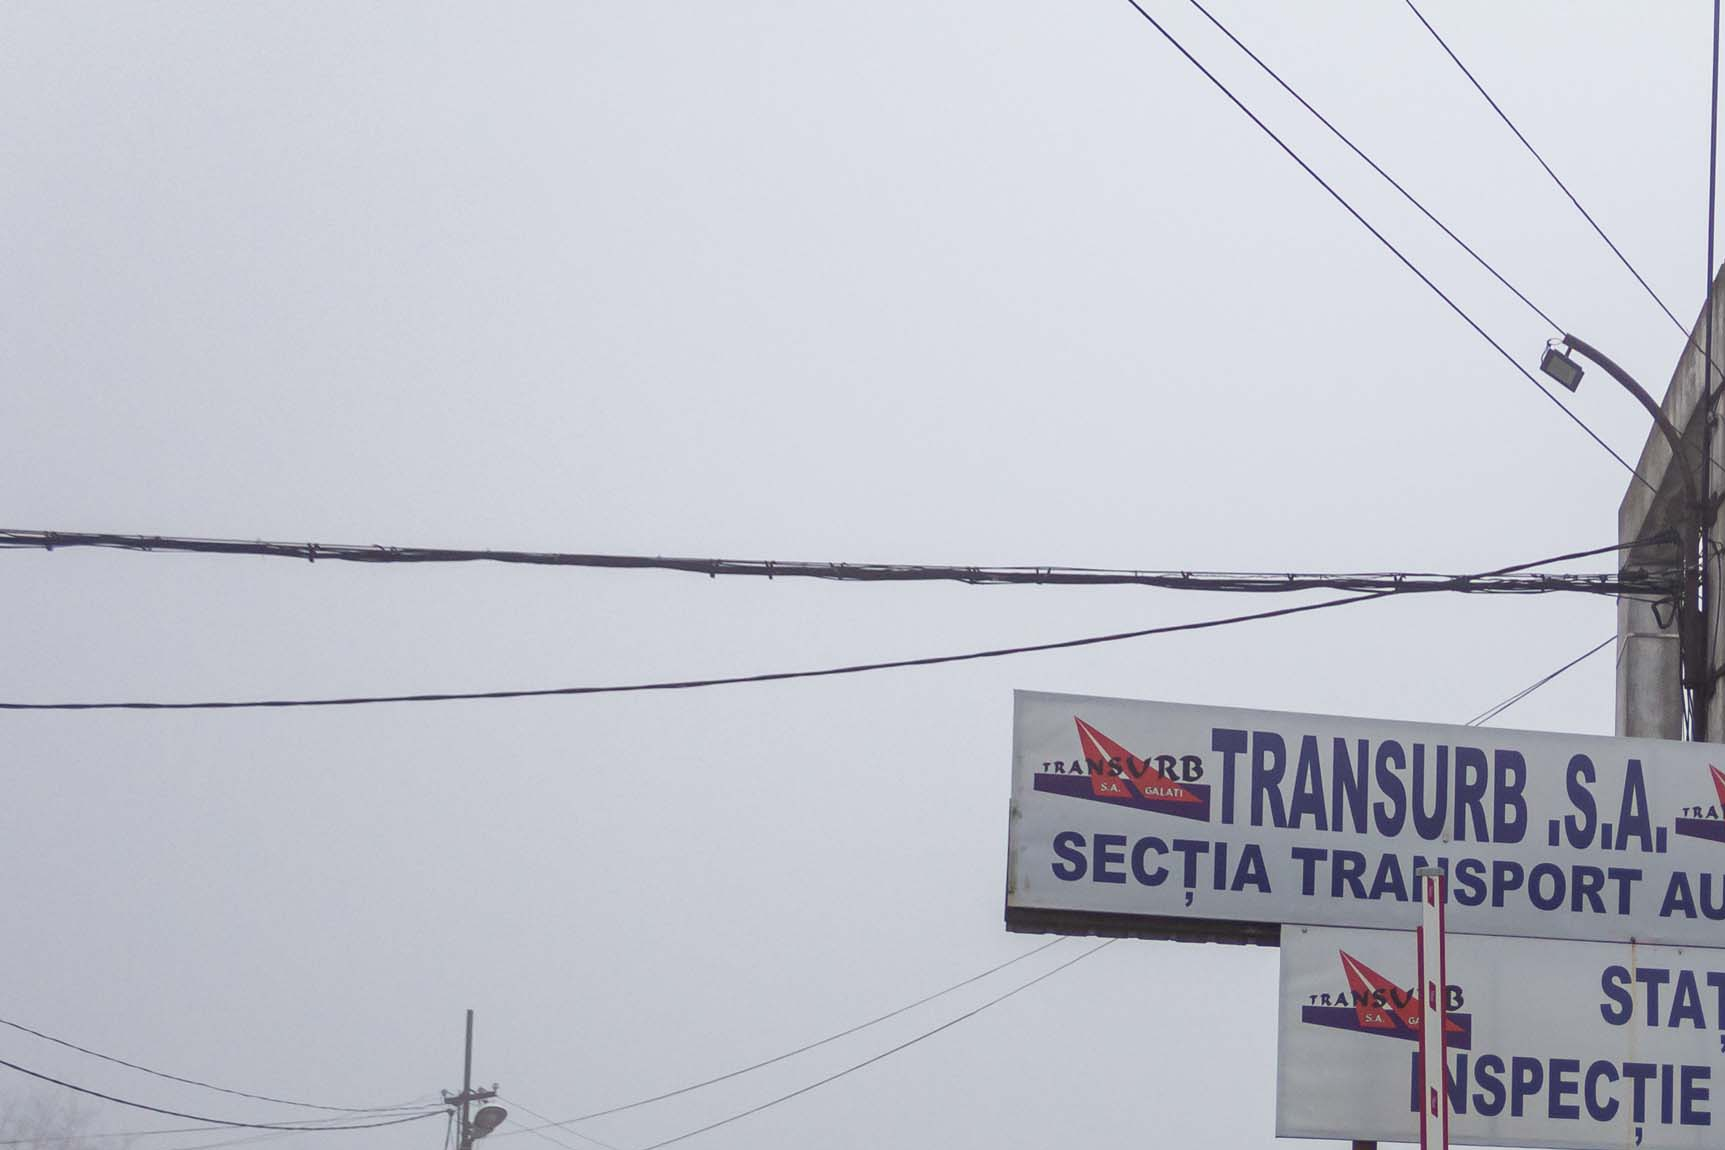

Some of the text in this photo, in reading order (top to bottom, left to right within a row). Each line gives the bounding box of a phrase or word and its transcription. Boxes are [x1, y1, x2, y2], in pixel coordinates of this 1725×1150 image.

[1043, 755, 1203, 782] TRANSURB
[1100, 783, 1121, 793] S.A.
[1211, 728, 1527, 844] TRANSURB
[1051, 831, 1272, 906] SECȚIA
[1309, 985, 1464, 1011] TRANSUB
